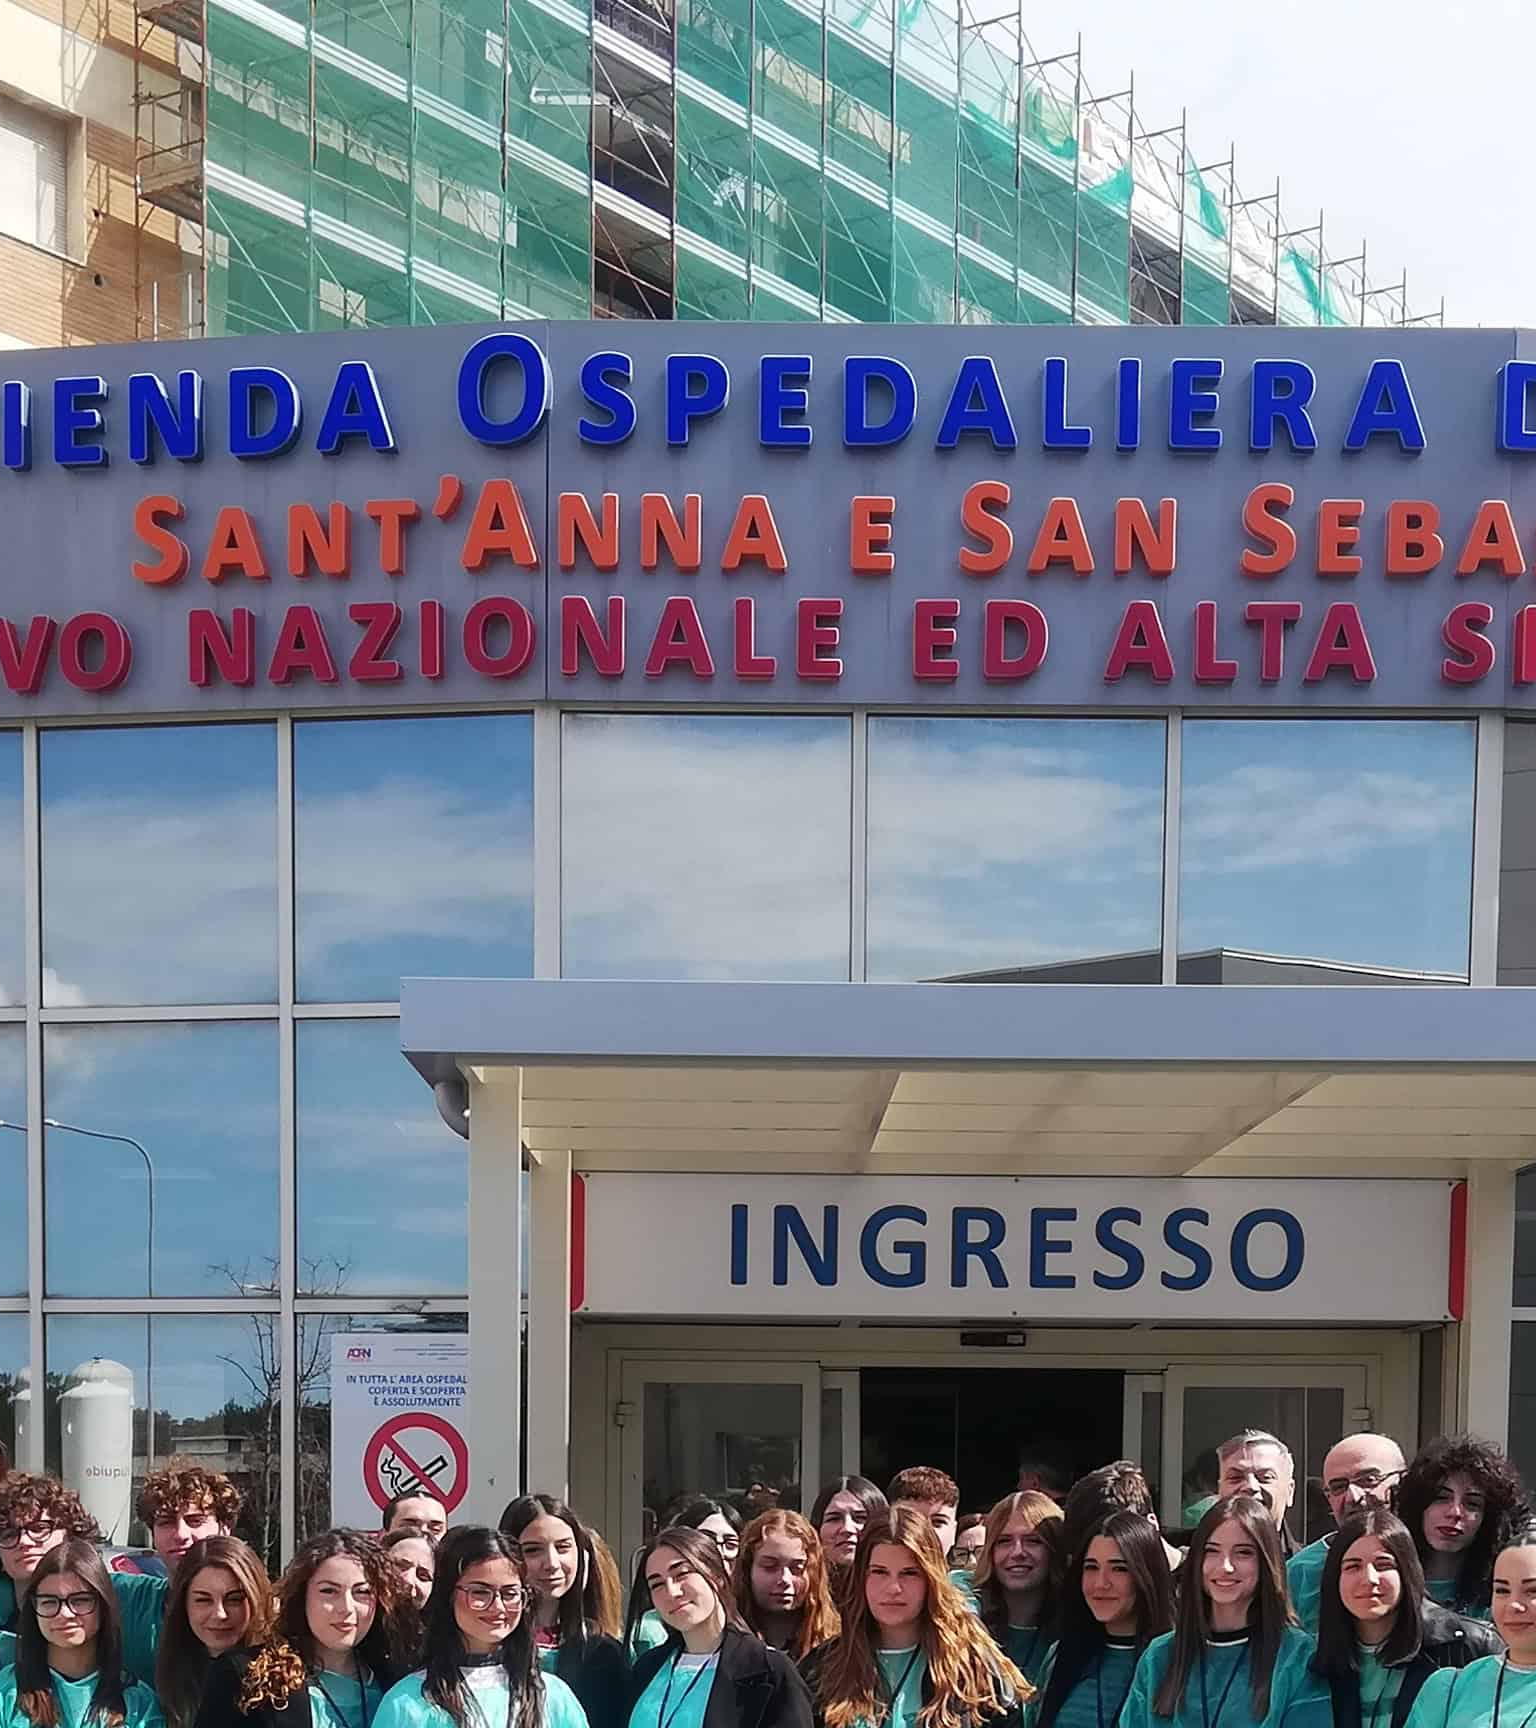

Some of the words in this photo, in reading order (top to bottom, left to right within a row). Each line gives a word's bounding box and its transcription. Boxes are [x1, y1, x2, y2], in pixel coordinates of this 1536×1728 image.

[459, 332, 1426, 453] OSPEDALIERA
[134, 474, 786, 586] SANT'ANNA
[851, 496, 897, 572] E
[959, 481, 1176, 576] SAN
[189, 594, 844, 687] NAZIONALE
[912, 597, 1048, 683] ED
[1104, 600, 1378, 683] ALTA
[729, 1203, 1306, 1291] INGRESSO
[346, 1375, 357, 1384] IN
[359, 1375, 387, 1384] TUTTA
[399, 1375, 424, 1384] AREA
[368, 1386, 409, 1395] COPERTA
[419, 1386, 467, 1395] SCOPERTA
[381, 1397, 462, 1407] ASSOLUTAMENTE
